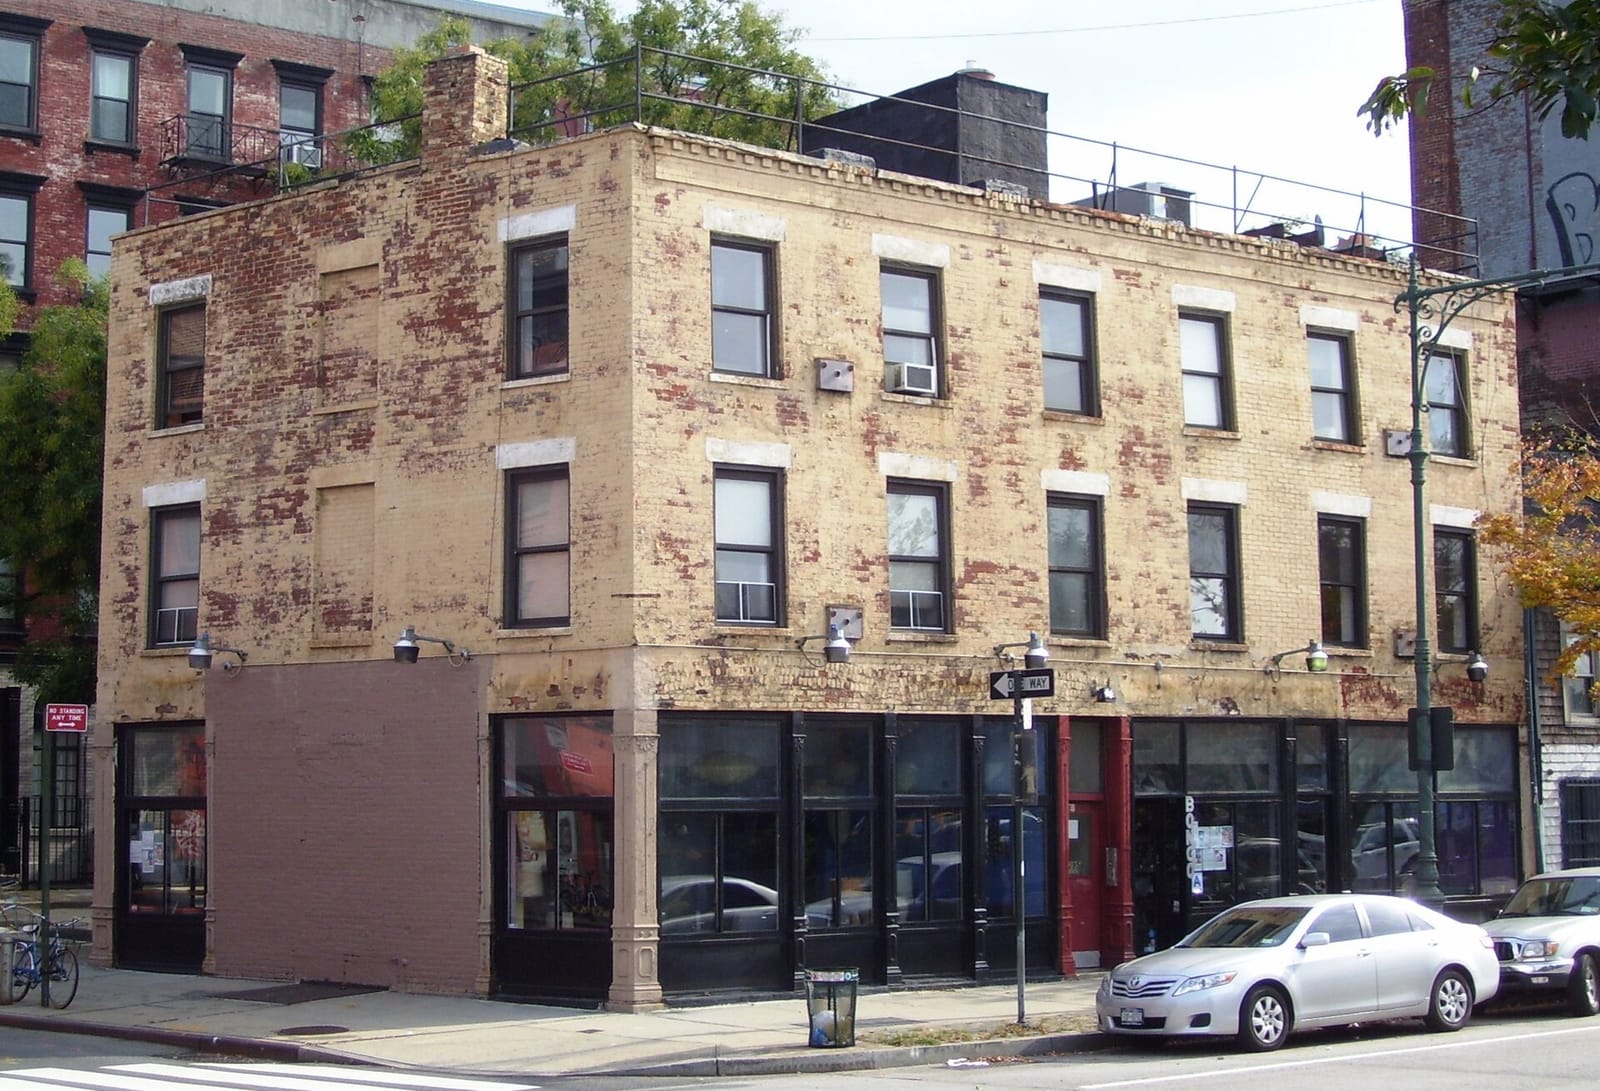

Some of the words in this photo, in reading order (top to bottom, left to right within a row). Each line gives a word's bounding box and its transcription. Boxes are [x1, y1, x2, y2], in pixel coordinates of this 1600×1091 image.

[1030, 677, 1047, 688] WAY
[59, 707, 85, 715] STANDING
[1193, 873, 1202, 888] A
